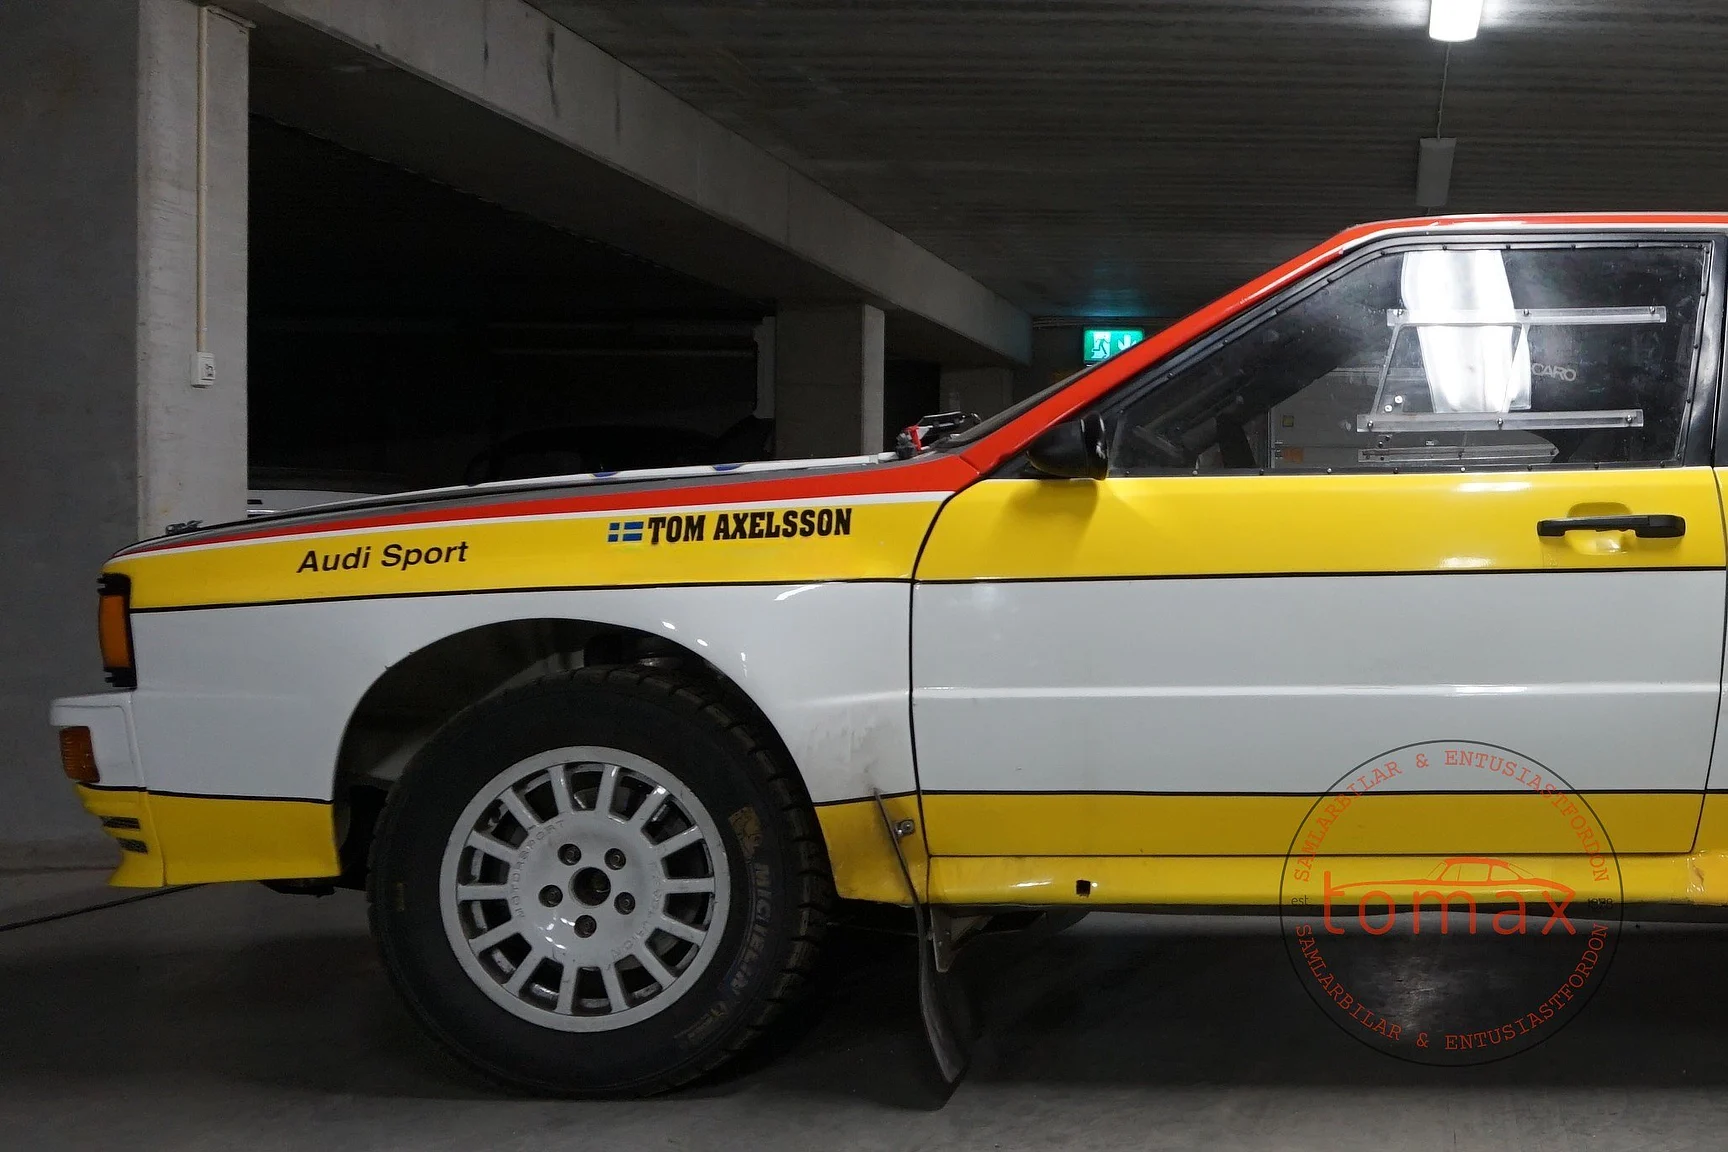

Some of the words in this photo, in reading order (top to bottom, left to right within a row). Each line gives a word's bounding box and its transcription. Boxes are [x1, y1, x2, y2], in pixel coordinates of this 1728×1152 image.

[1531, 362, 1577, 382] CARO
[648, 514, 706, 545] TOM
[713, 507, 852, 541] AXELSSON
[297, 546, 370, 574] Audi
[381, 540, 469, 572] Sport
